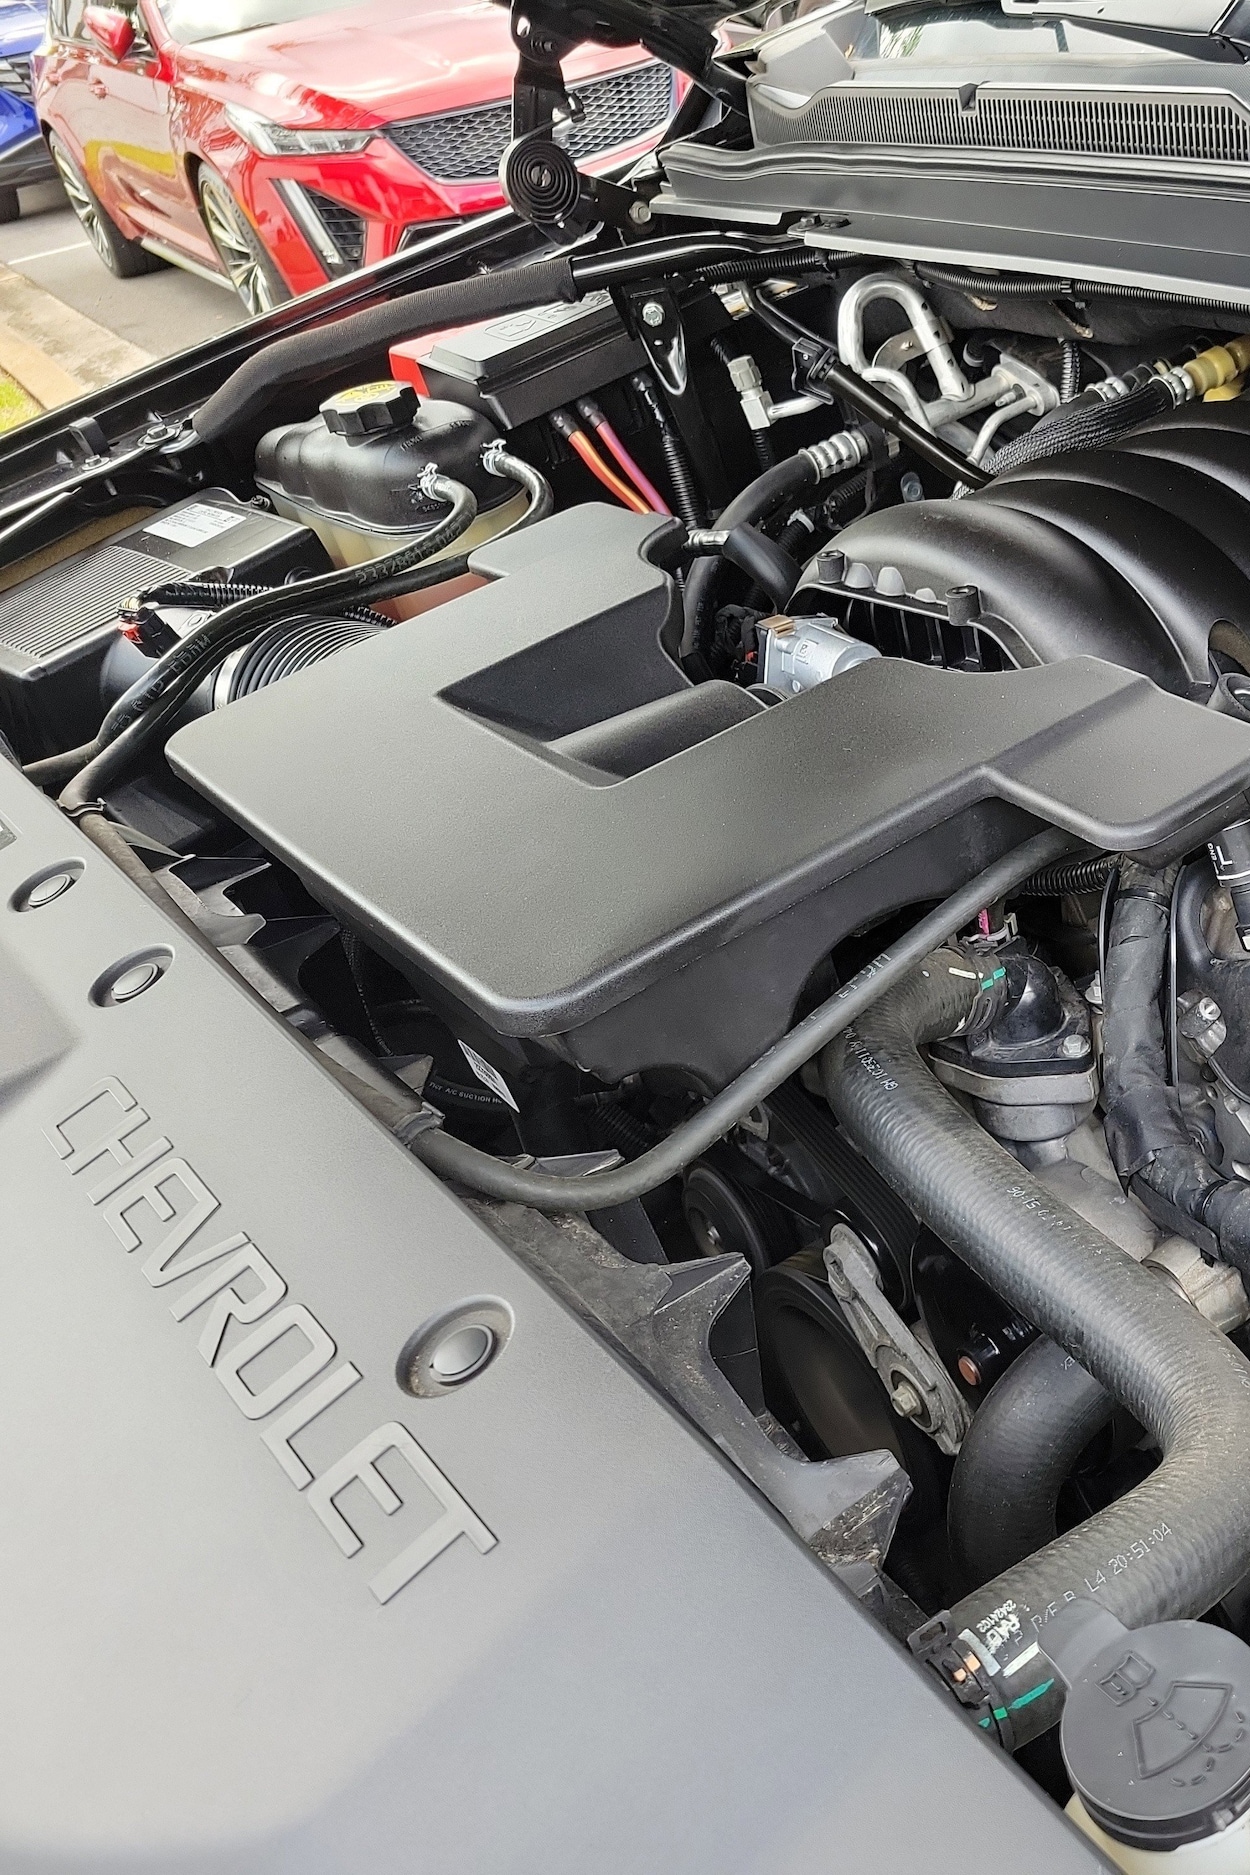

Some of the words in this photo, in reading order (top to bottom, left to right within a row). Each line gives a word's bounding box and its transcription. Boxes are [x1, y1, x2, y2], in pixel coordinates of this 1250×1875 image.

[1207, 842, 1217, 861] ENG
[458, 1091, 491, 1104] SUCTION
[41, 1074, 500, 1606] CHEVROLET
[1083, 1569, 1107, 1593] L4
[1107, 1522, 1173, 1576] 20:51:04
